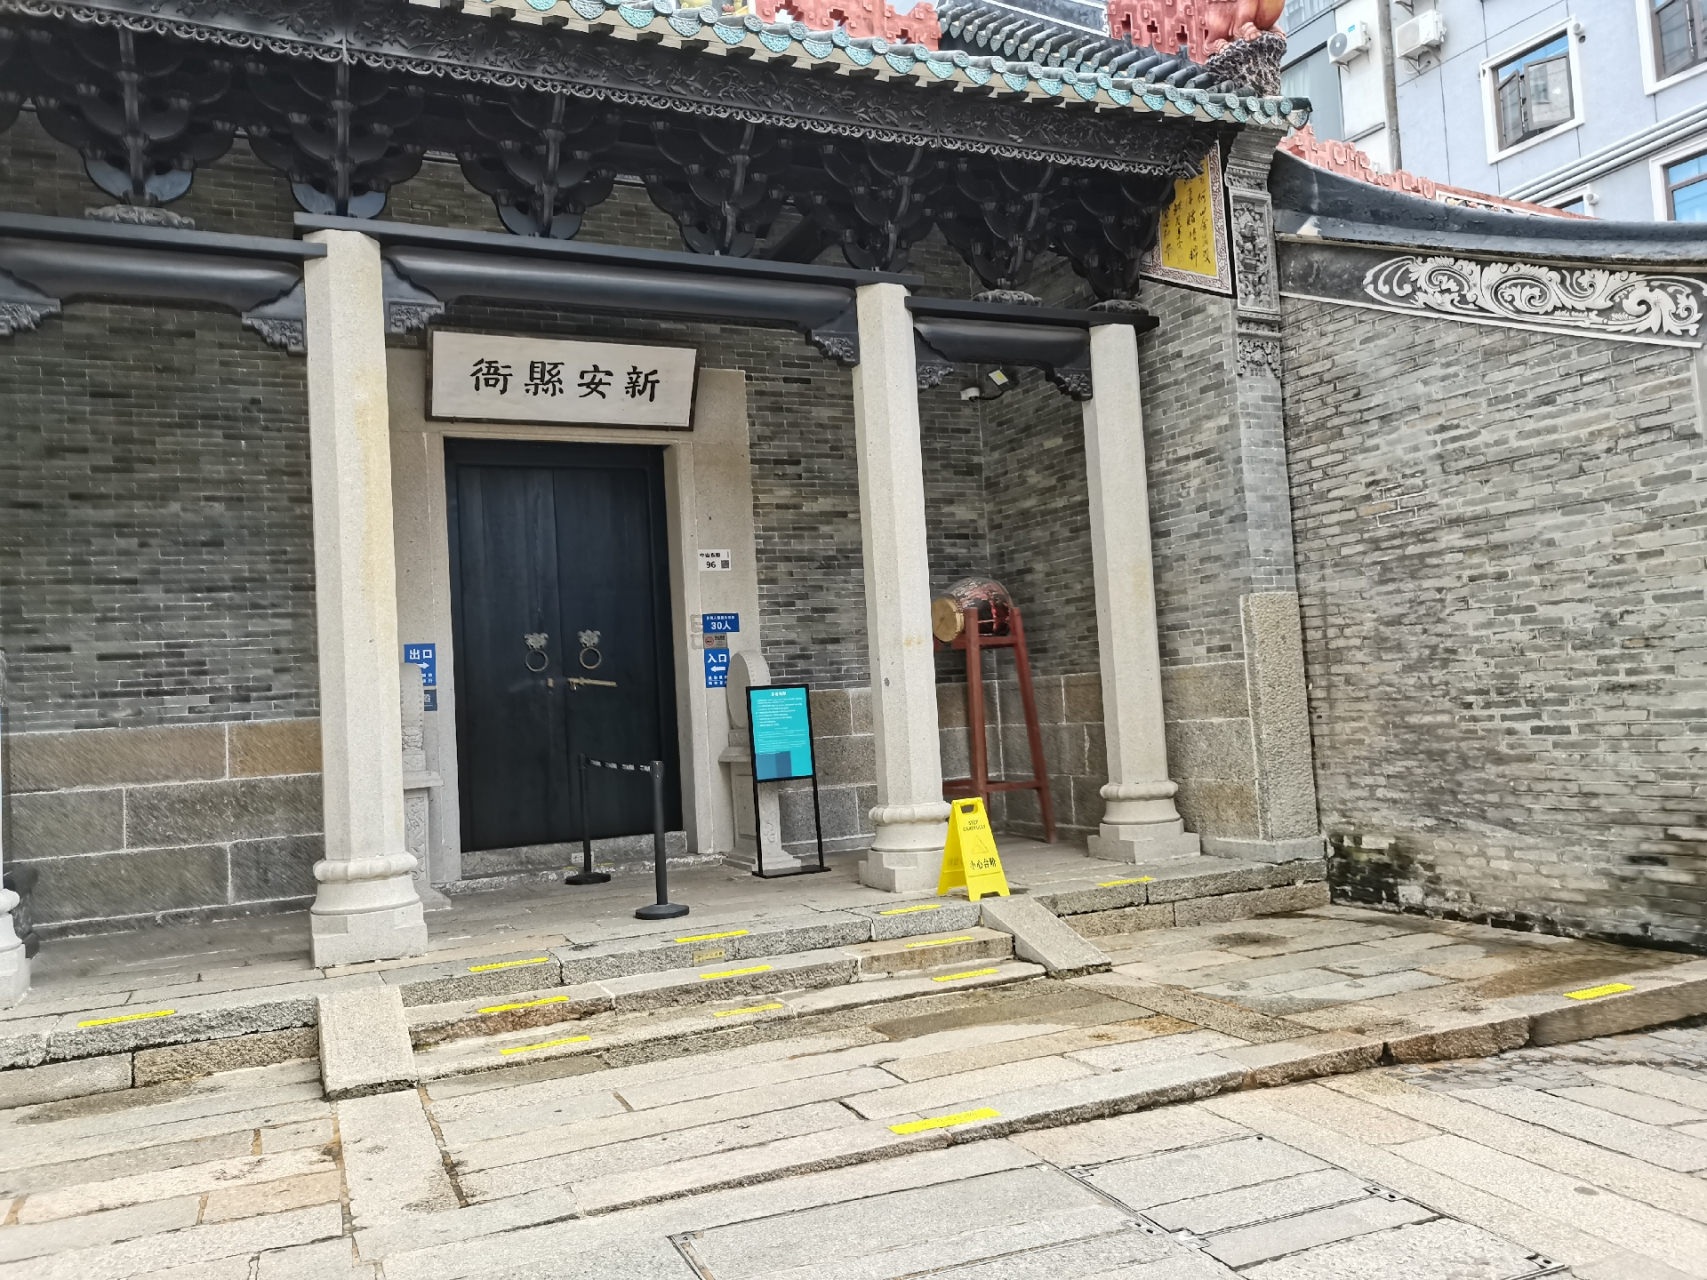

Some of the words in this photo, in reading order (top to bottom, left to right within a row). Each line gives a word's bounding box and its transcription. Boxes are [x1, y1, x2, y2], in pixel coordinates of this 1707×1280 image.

[470, 358, 660, 402] 新安縣衙
[706, 561, 717, 569] 96
[711, 620, 731, 630] 30人
[409, 648, 433, 660] 出口
[707, 653, 727, 663] 入口
